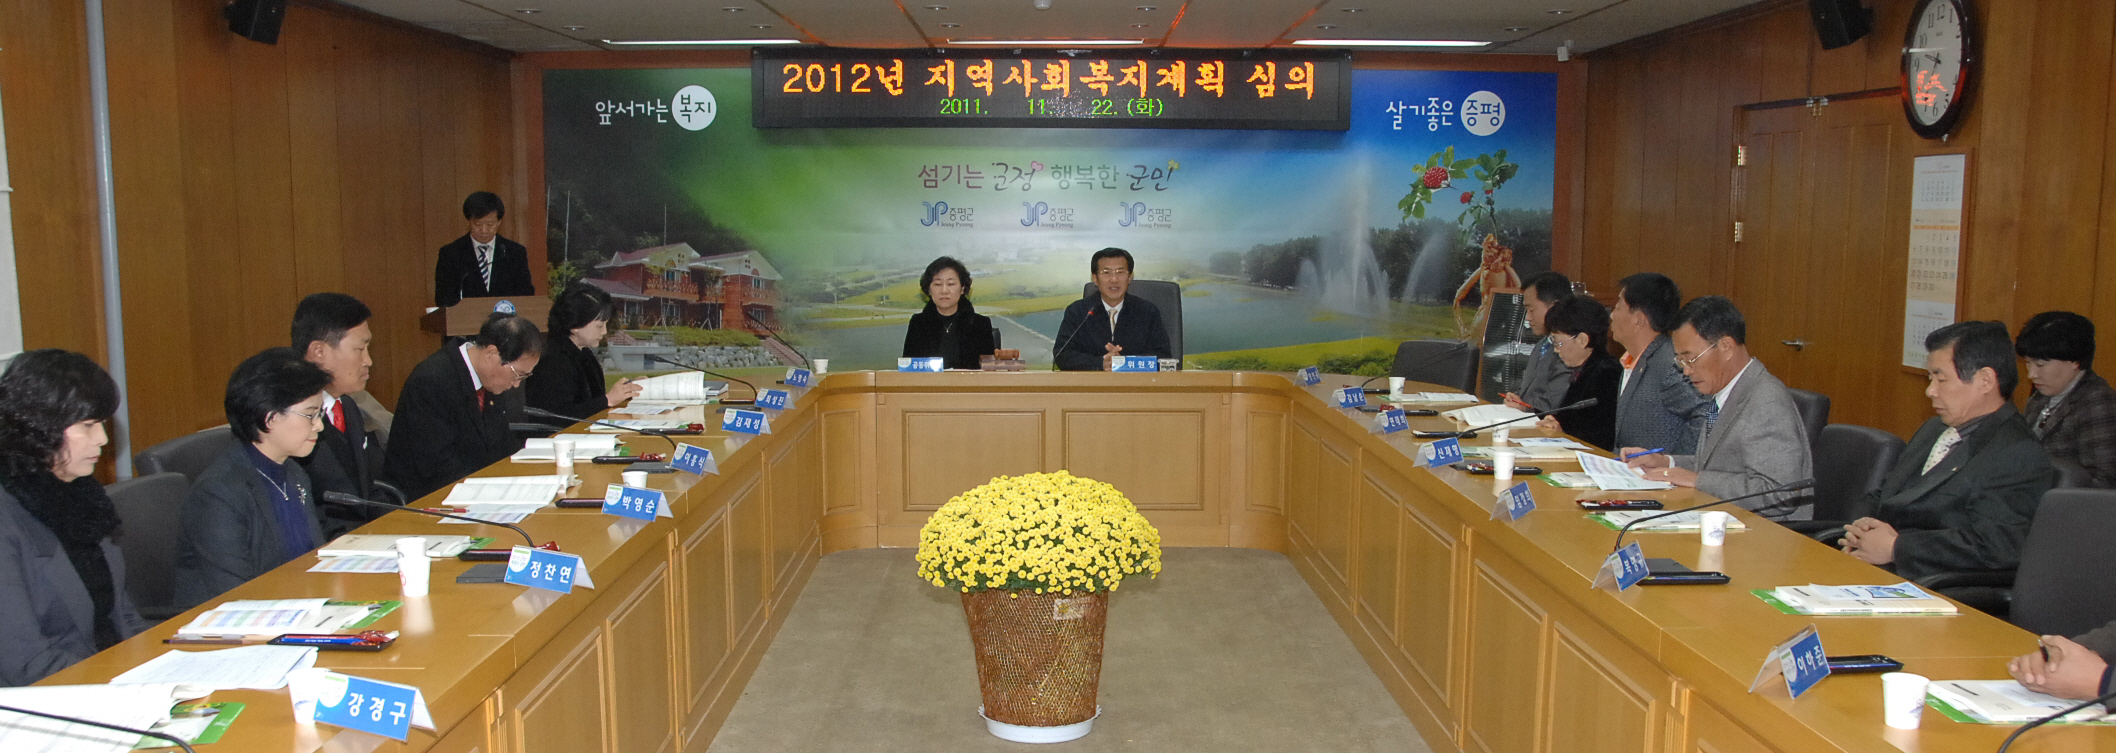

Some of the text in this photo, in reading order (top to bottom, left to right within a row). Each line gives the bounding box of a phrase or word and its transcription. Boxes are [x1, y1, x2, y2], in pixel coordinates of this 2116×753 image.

[783, 59, 1314, 99] 2012년 지역사회복지계획 심의
[595, 94, 711, 125] 앞서가는 복지
[939, 98, 989, 115] 2011.
[1385, 97, 1500, 131] 살기좋은 증평
[918, 164, 985, 189] 섬기는
[1050, 164, 1120, 191] 행복한
[1126, 164, 1174, 192] 군민
[949, 207, 974, 222] 증평군
[1049, 208, 1074, 222] 증평군
[1147, 208, 1172, 223] 증평군
[1127, 360, 1156, 369] 위원장
[735, 416, 761, 430] 김재성
[622, 495, 656, 514] 박영순
[530, 560, 572, 584] 정찬연
[1796, 645, 1825, 676] 이하준
[347, 692, 407, 726] 강경구
